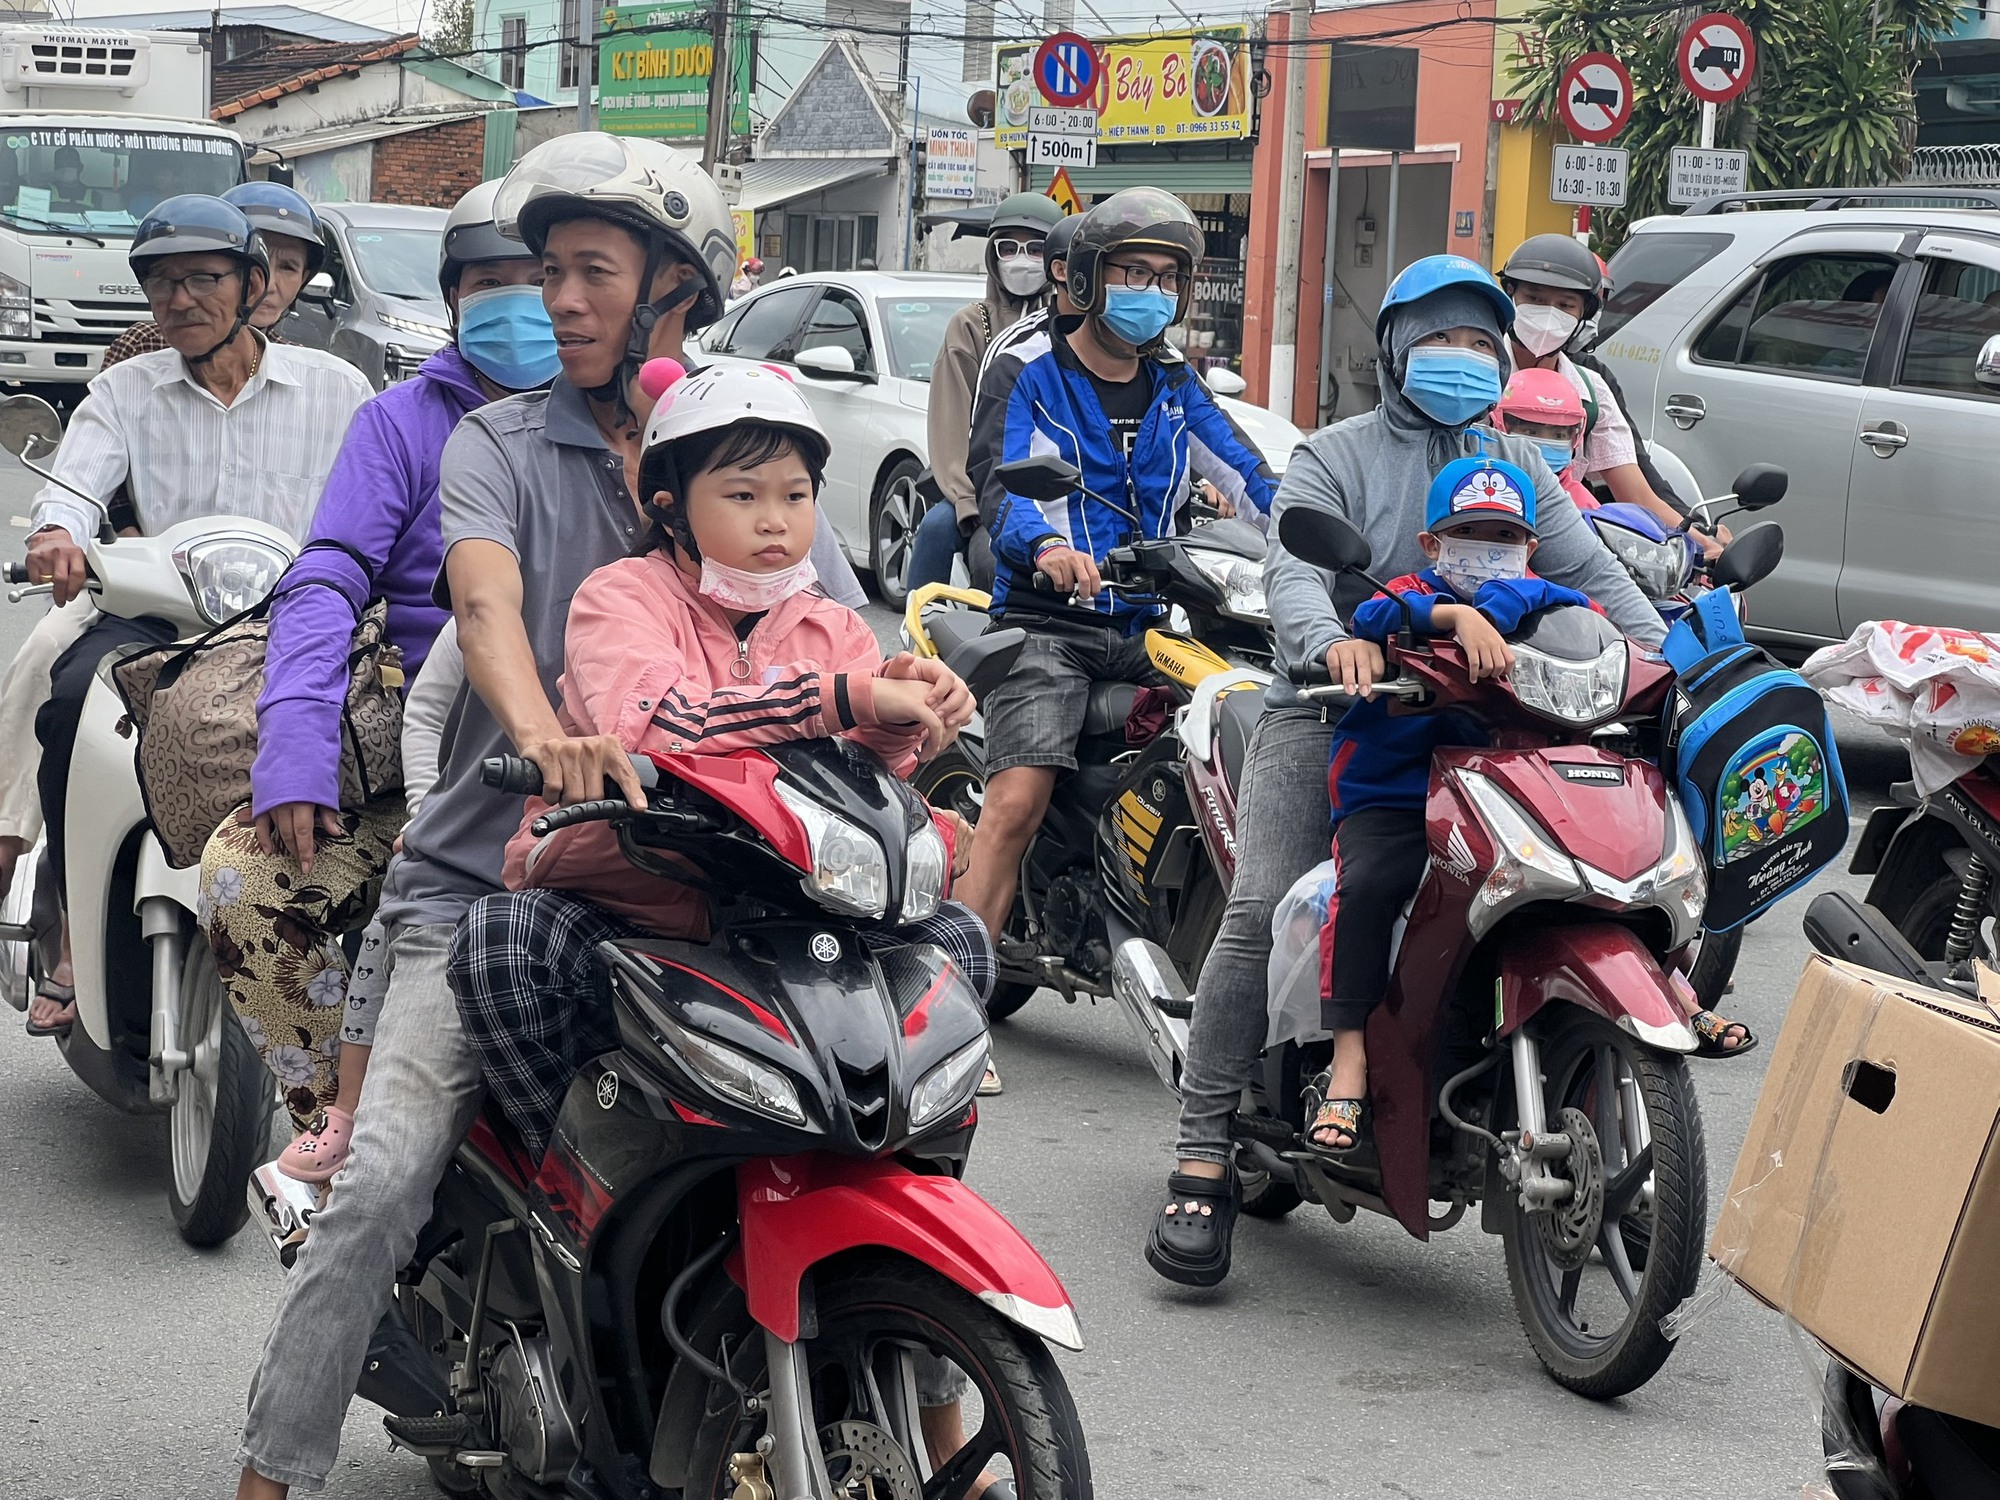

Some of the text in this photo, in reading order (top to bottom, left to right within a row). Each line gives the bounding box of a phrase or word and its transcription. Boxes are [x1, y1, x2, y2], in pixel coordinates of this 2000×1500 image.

[43, 35, 129, 46] THERMAL MASTER
[637, 41, 671, 79] BÌNH
[1722, 50, 1732, 62] 10
[1116, 57, 1154, 113] Bảy
[1162, 53, 1188, 100] Bò
[1034, 114, 1057, 126] 6:00
[1068, 115, 1093, 128] 20:00
[1190, 122, 1207, 133] 0966
[1210, 122, 1218, 131] 33
[1221, 120, 1229, 131] 55
[1231, 120, 1240, 130] 42
[31, 131, 38, 146] C
[39, 131, 51, 146] TY
[54, 129, 67, 146] CỔ
[146, 134, 181, 153] TRƯỜNG
[183, 135, 203, 153] BÌNH
[205, 140, 233, 157] DƯƠNG
[929, 140, 975, 162] MINH THUẬN
[1042, 140, 1082, 159] 500m
[1565, 155, 1586, 171] 6:00
[1596, 157, 1617, 173] 8:00
[1678, 155, 1703, 169] 11:00
[1558, 178, 1583, 194] 16:30
[1595, 181, 1621, 197] 18:30
[99, 284, 143, 295] ISUZ
[1154, 650, 1185, 677] YAMAHA
[1567, 769, 1620, 780] HONDA
[1945, 793, 1967, 817] AIR
[1431, 853, 1471, 887] HONDA
[575, 1150, 614, 1190] INJECTION
